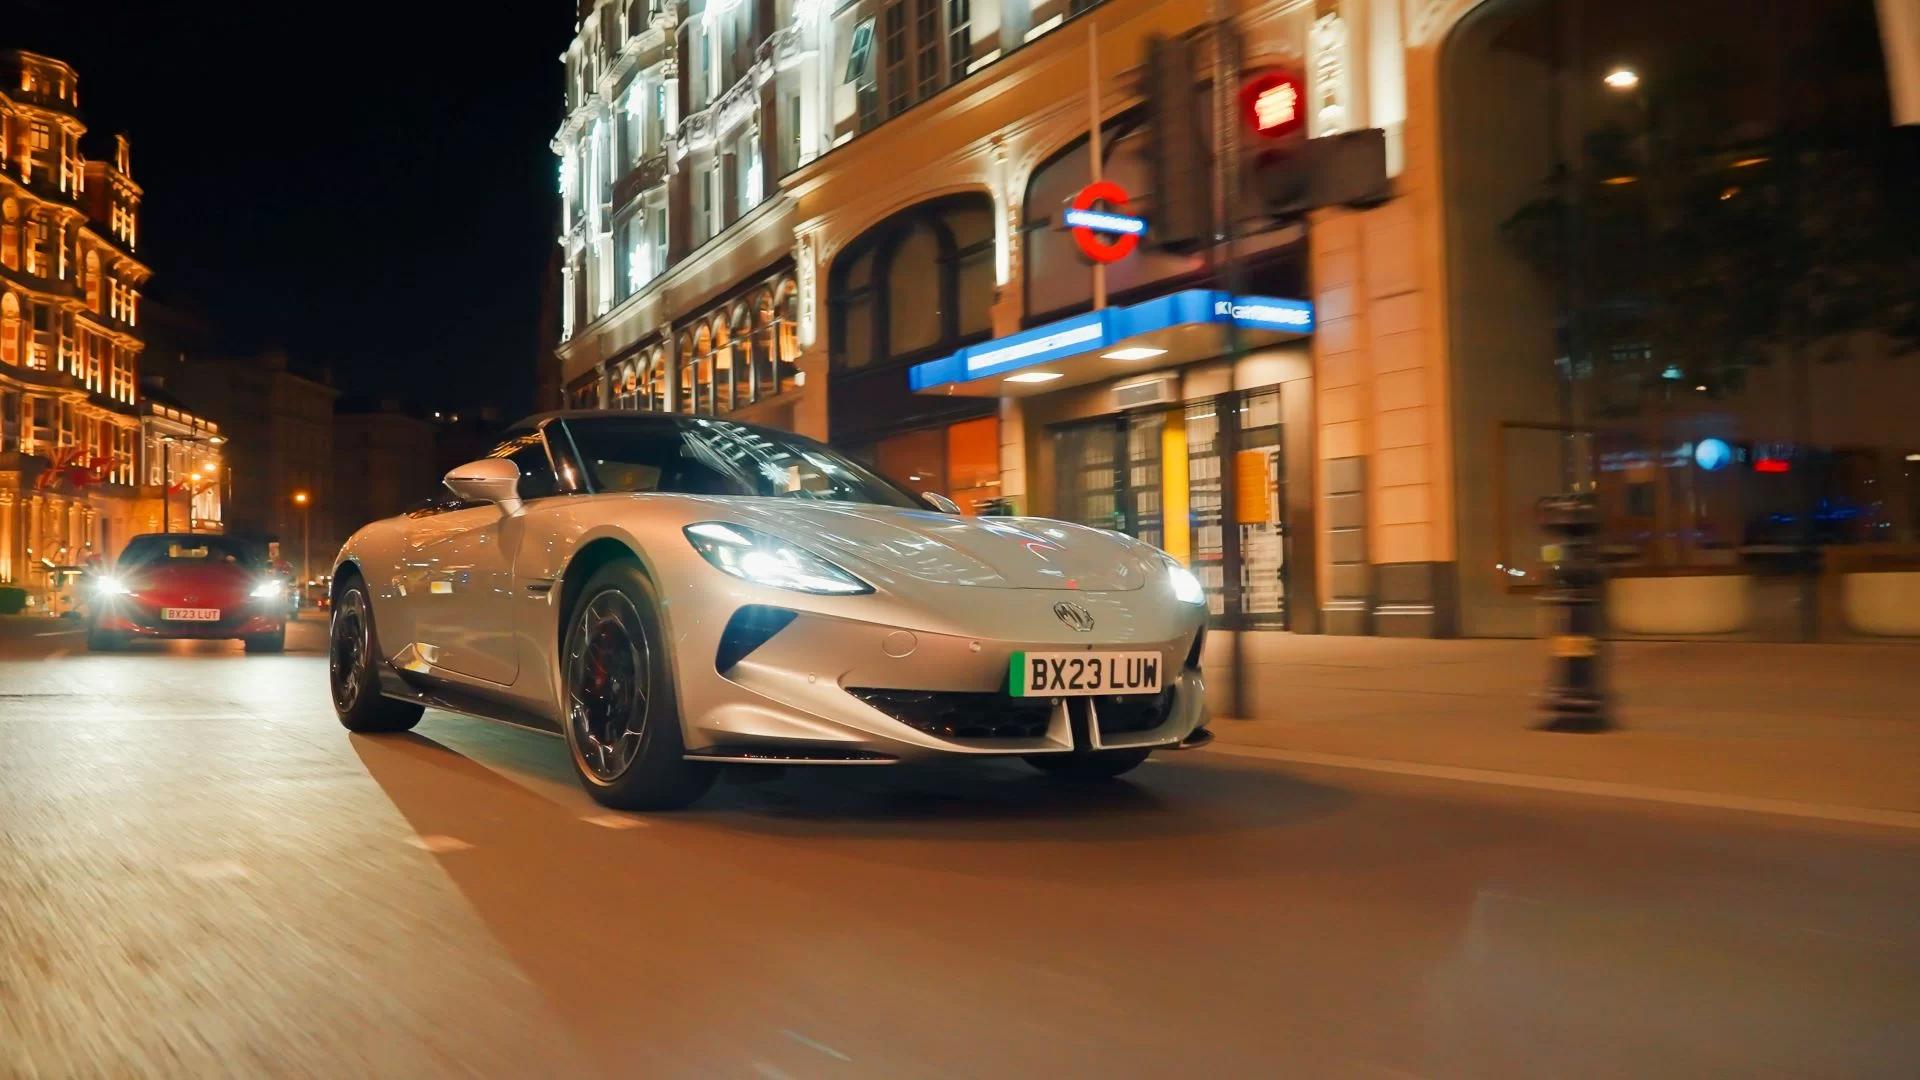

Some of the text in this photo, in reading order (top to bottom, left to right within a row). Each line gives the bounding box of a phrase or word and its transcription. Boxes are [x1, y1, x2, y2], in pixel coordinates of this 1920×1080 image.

[168, 609, 217, 619] BX23 LUT
[1031, 657, 1157, 690] BX23 LUW
